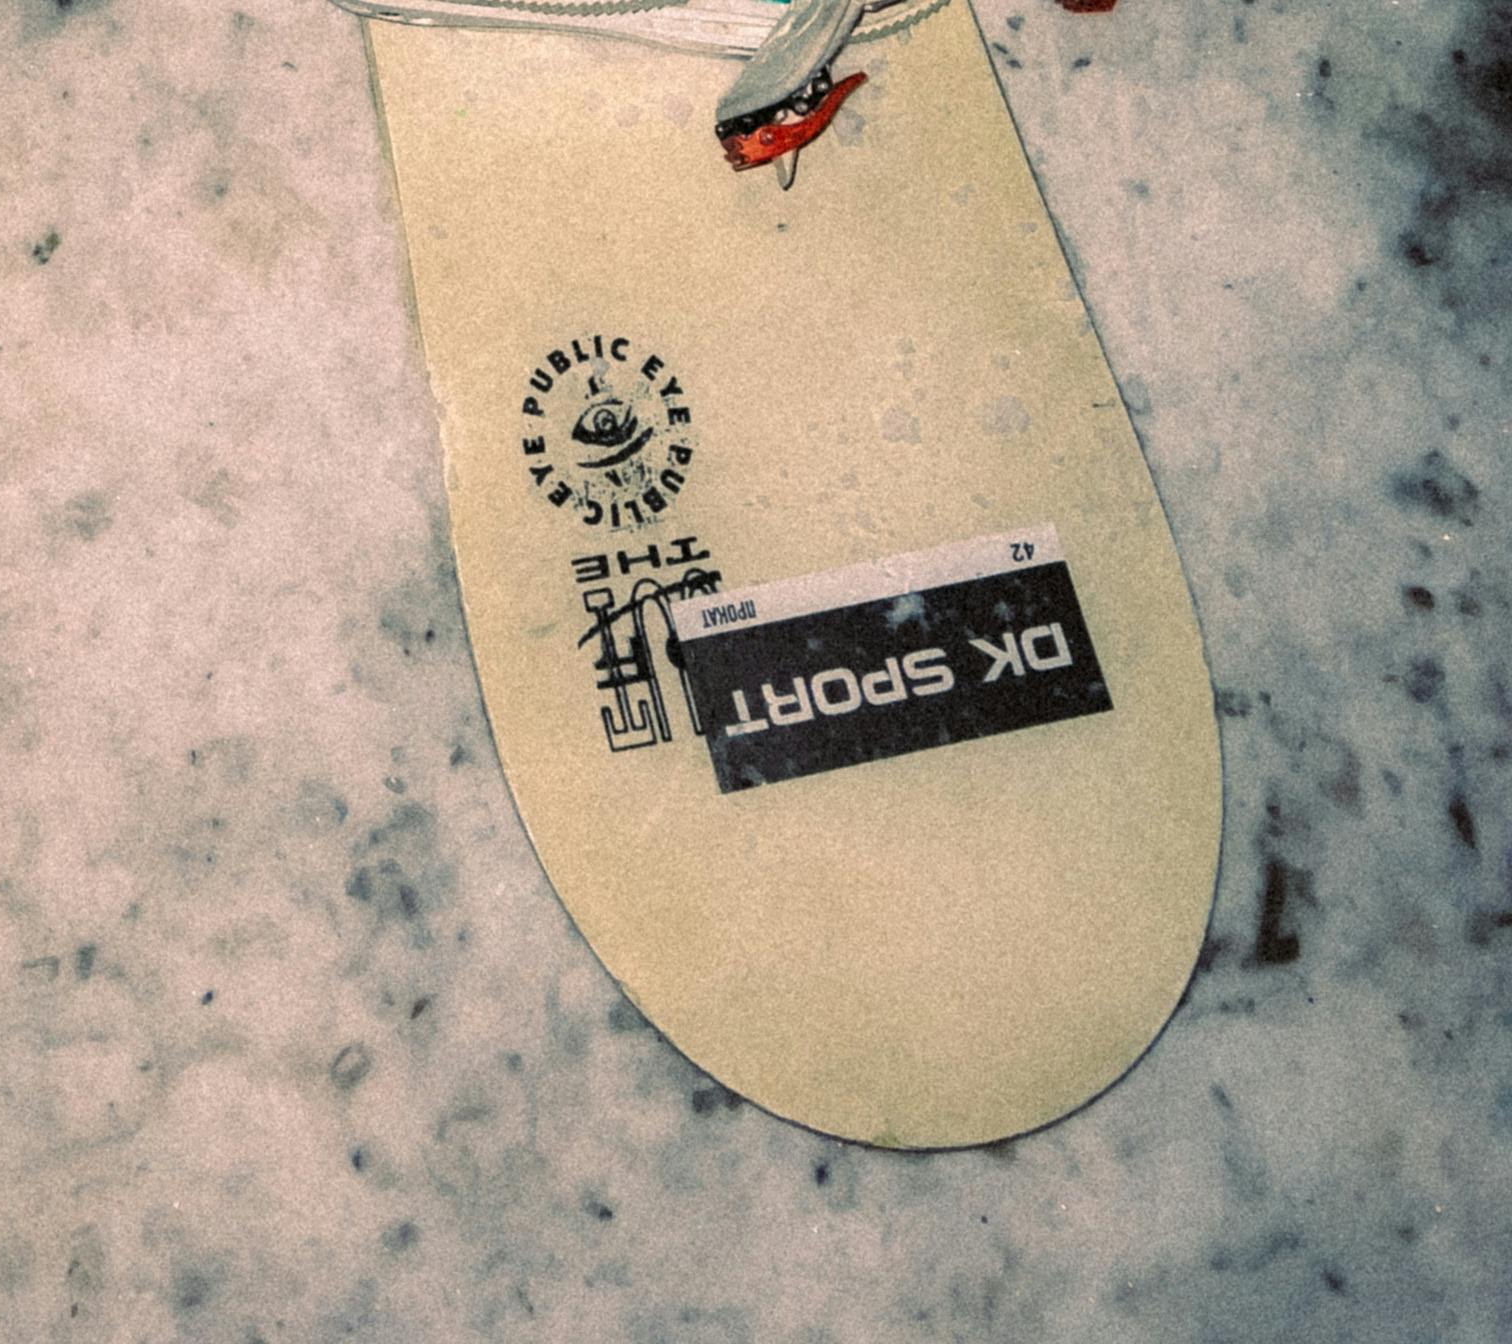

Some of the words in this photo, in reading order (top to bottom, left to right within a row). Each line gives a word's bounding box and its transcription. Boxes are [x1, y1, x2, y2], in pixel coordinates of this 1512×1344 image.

[522, 334, 630, 416] PUBLIC
[641, 354, 692, 425] EYE
[522, 435, 573, 508] EYE
[583, 444, 694, 528] PUBLIC
[571, 536, 711, 584] THE
[1008, 541, 1036, 564] 42
[701, 598, 756, 630] ПРОКАТ
[968, 621, 1075, 685] DK
[724, 646, 956, 739] SPORT
